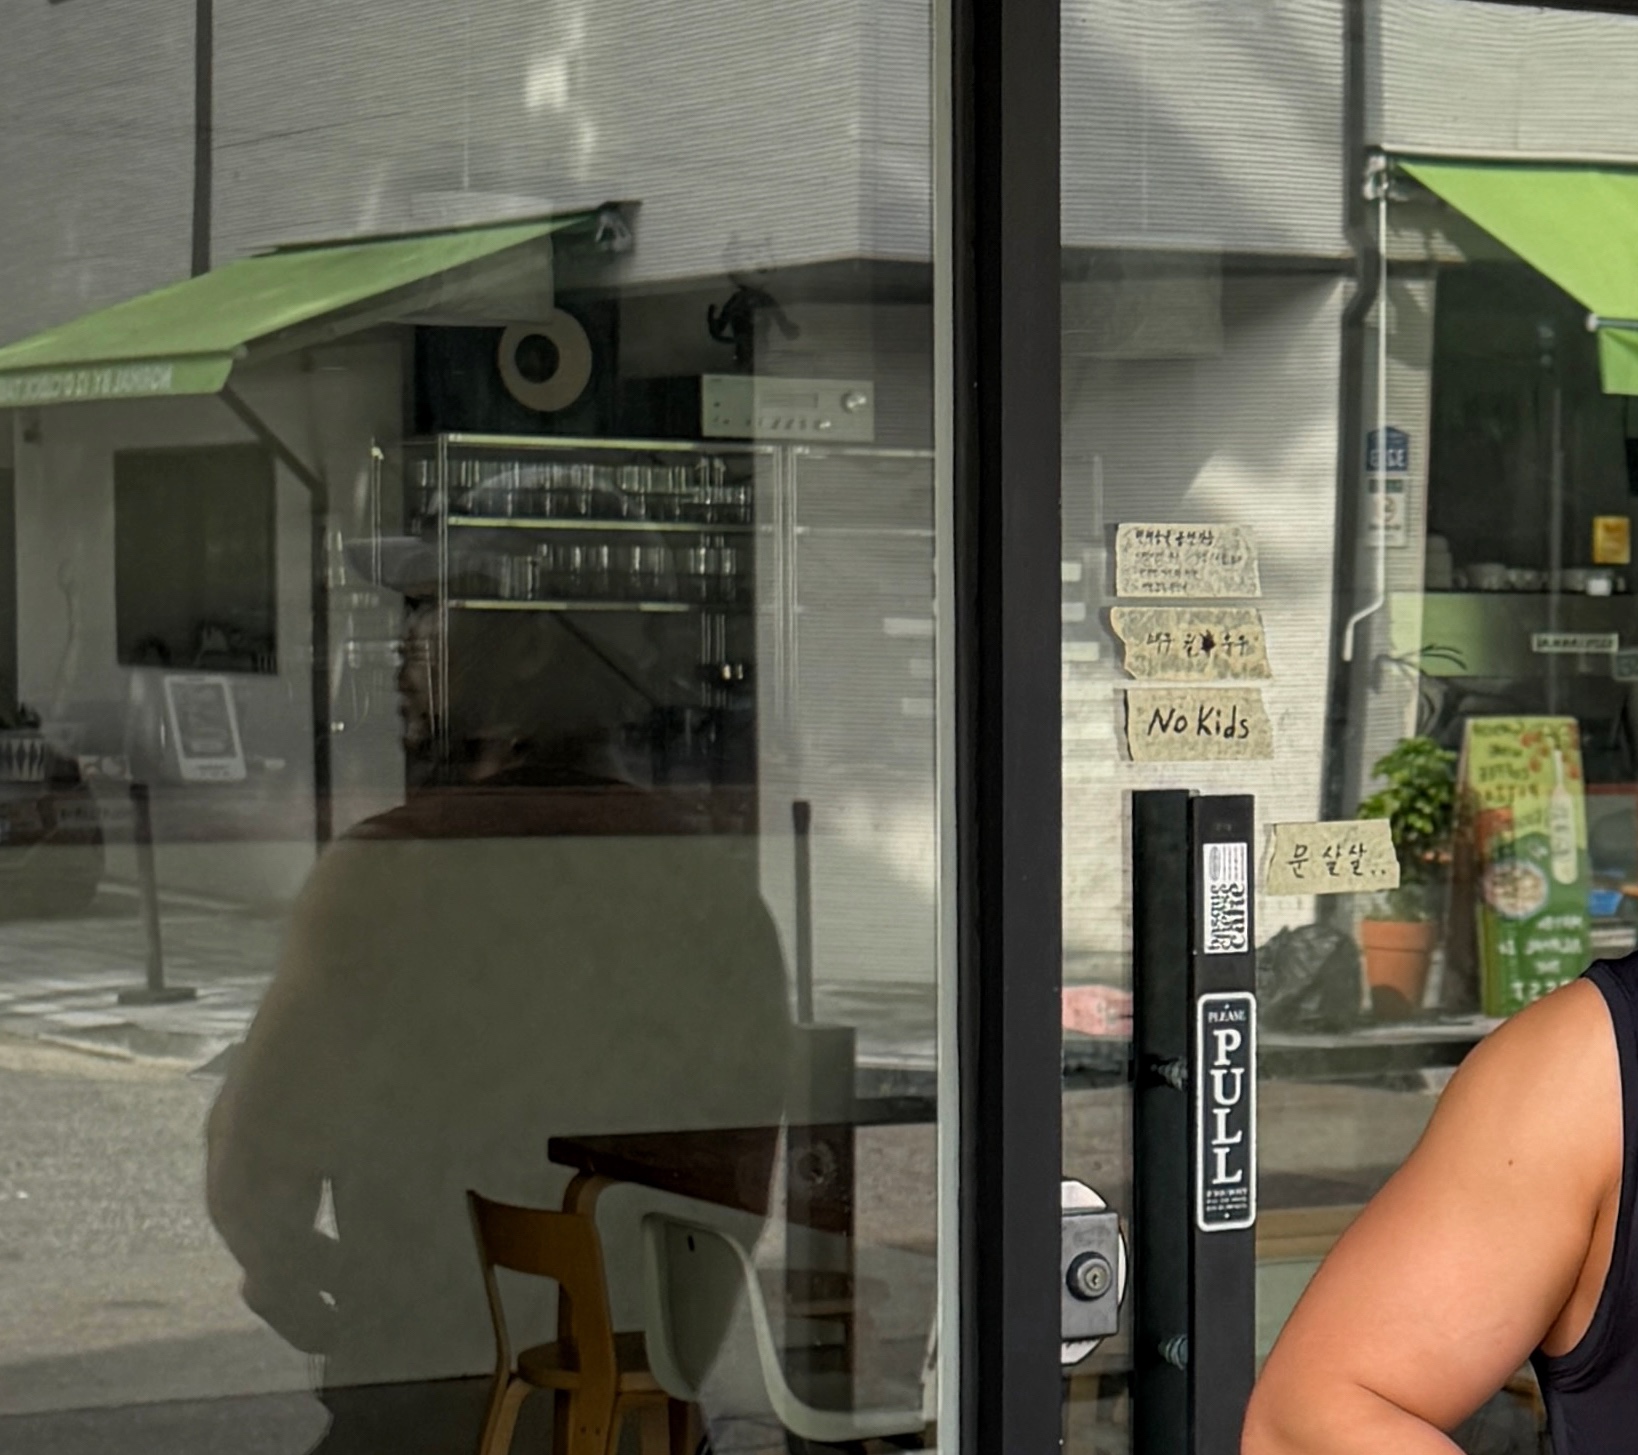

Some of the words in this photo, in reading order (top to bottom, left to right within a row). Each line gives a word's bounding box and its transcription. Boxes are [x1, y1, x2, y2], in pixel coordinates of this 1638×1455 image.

[1147, 707, 1188, 736] No
[1196, 704, 1249, 739] Kids
[1285, 843, 1309, 878] 문
[1208, 1009, 1246, 1023] PLEASE
[1209, 1029, 1245, 1185] PULL
